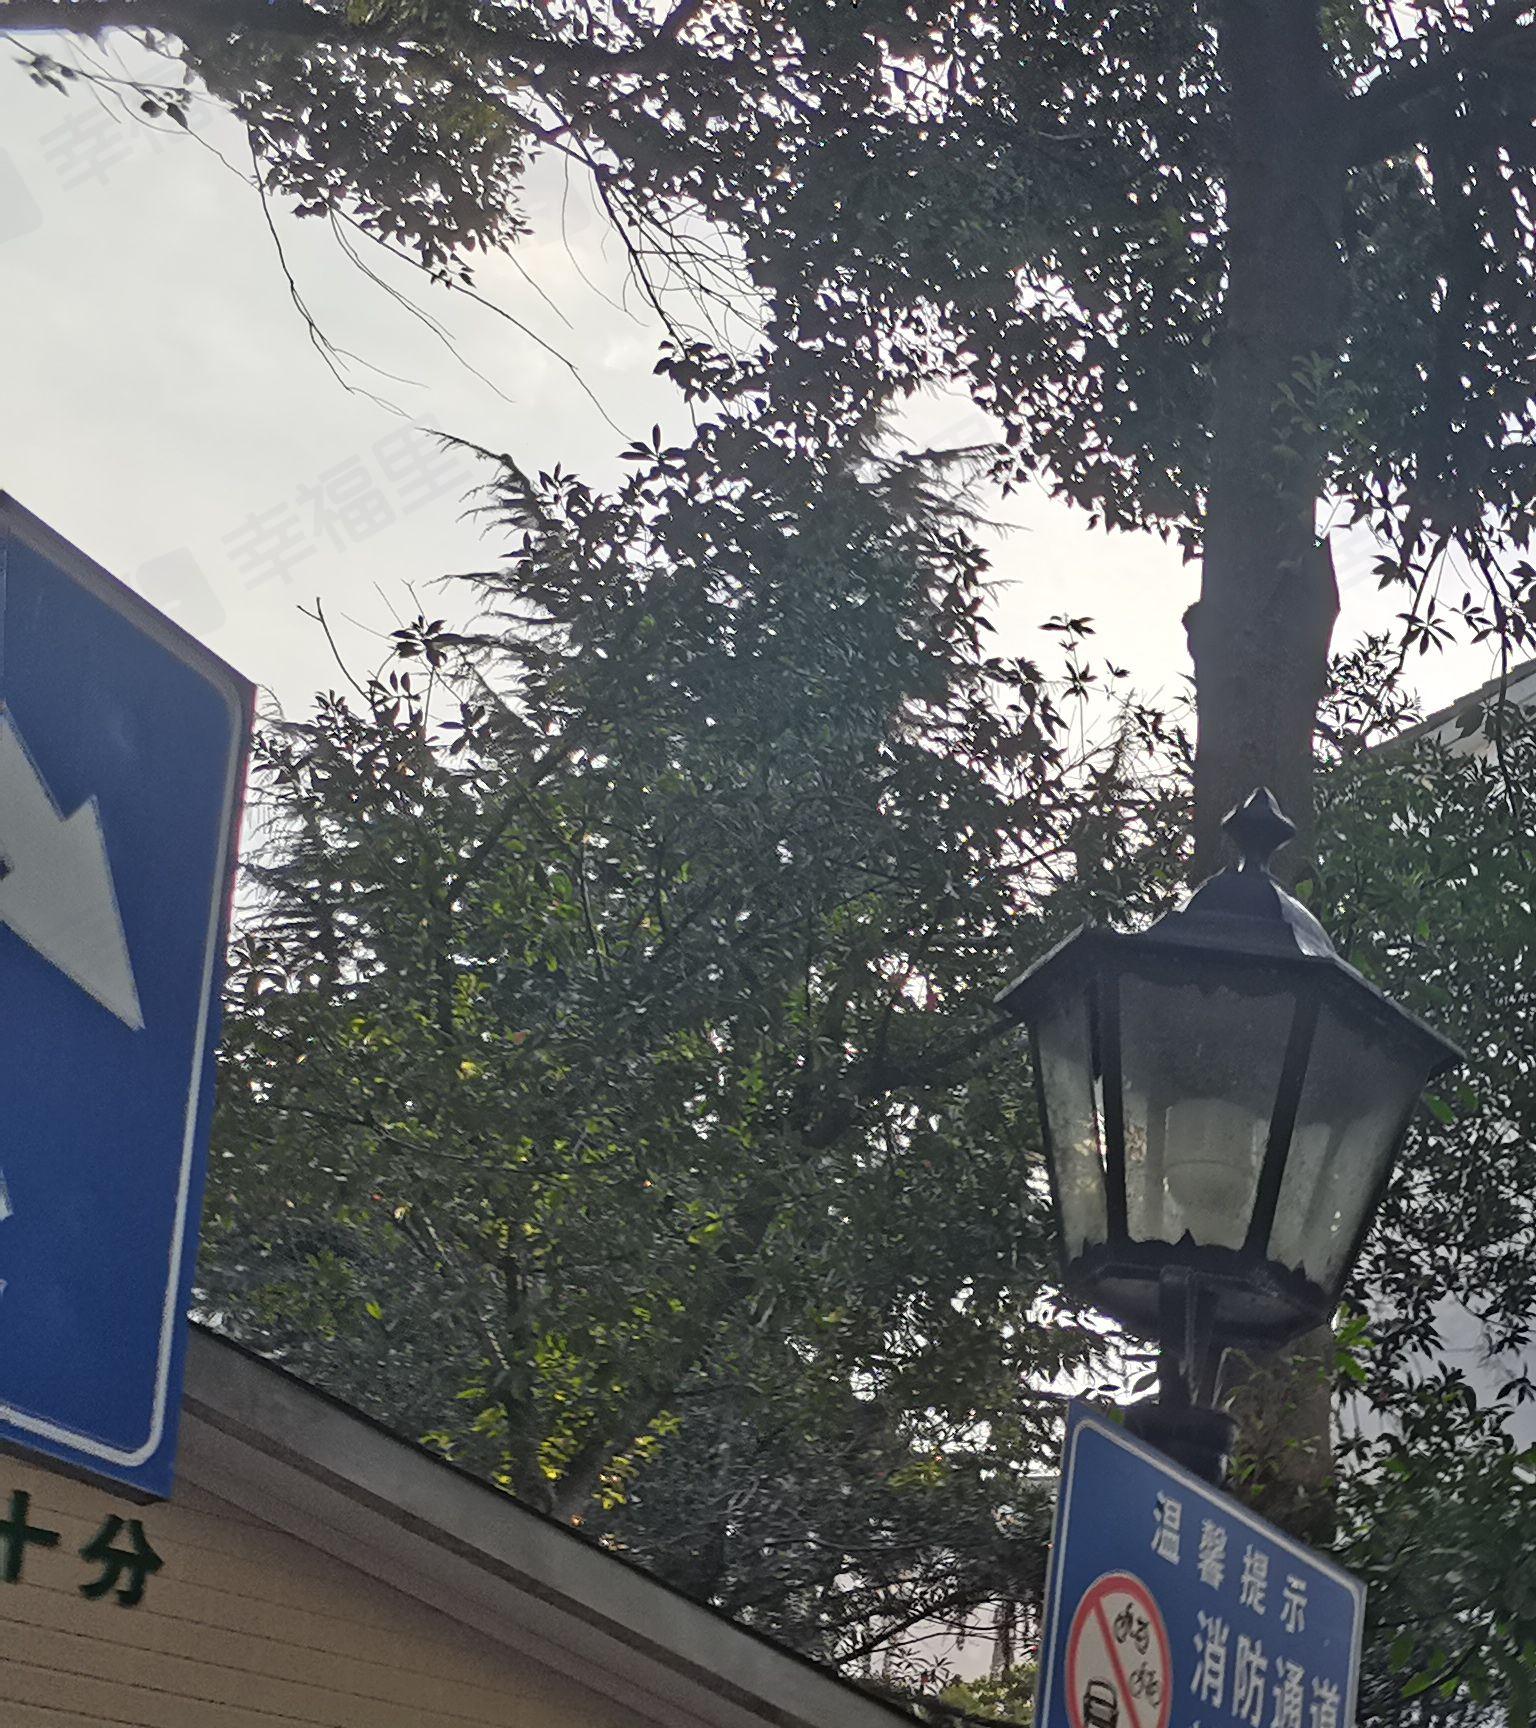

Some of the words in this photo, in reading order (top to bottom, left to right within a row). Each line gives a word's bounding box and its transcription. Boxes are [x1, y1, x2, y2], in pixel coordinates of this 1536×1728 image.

[0, 1490, 164, 1608] 十分
[1150, 1491, 1308, 1633] 温馨提示
